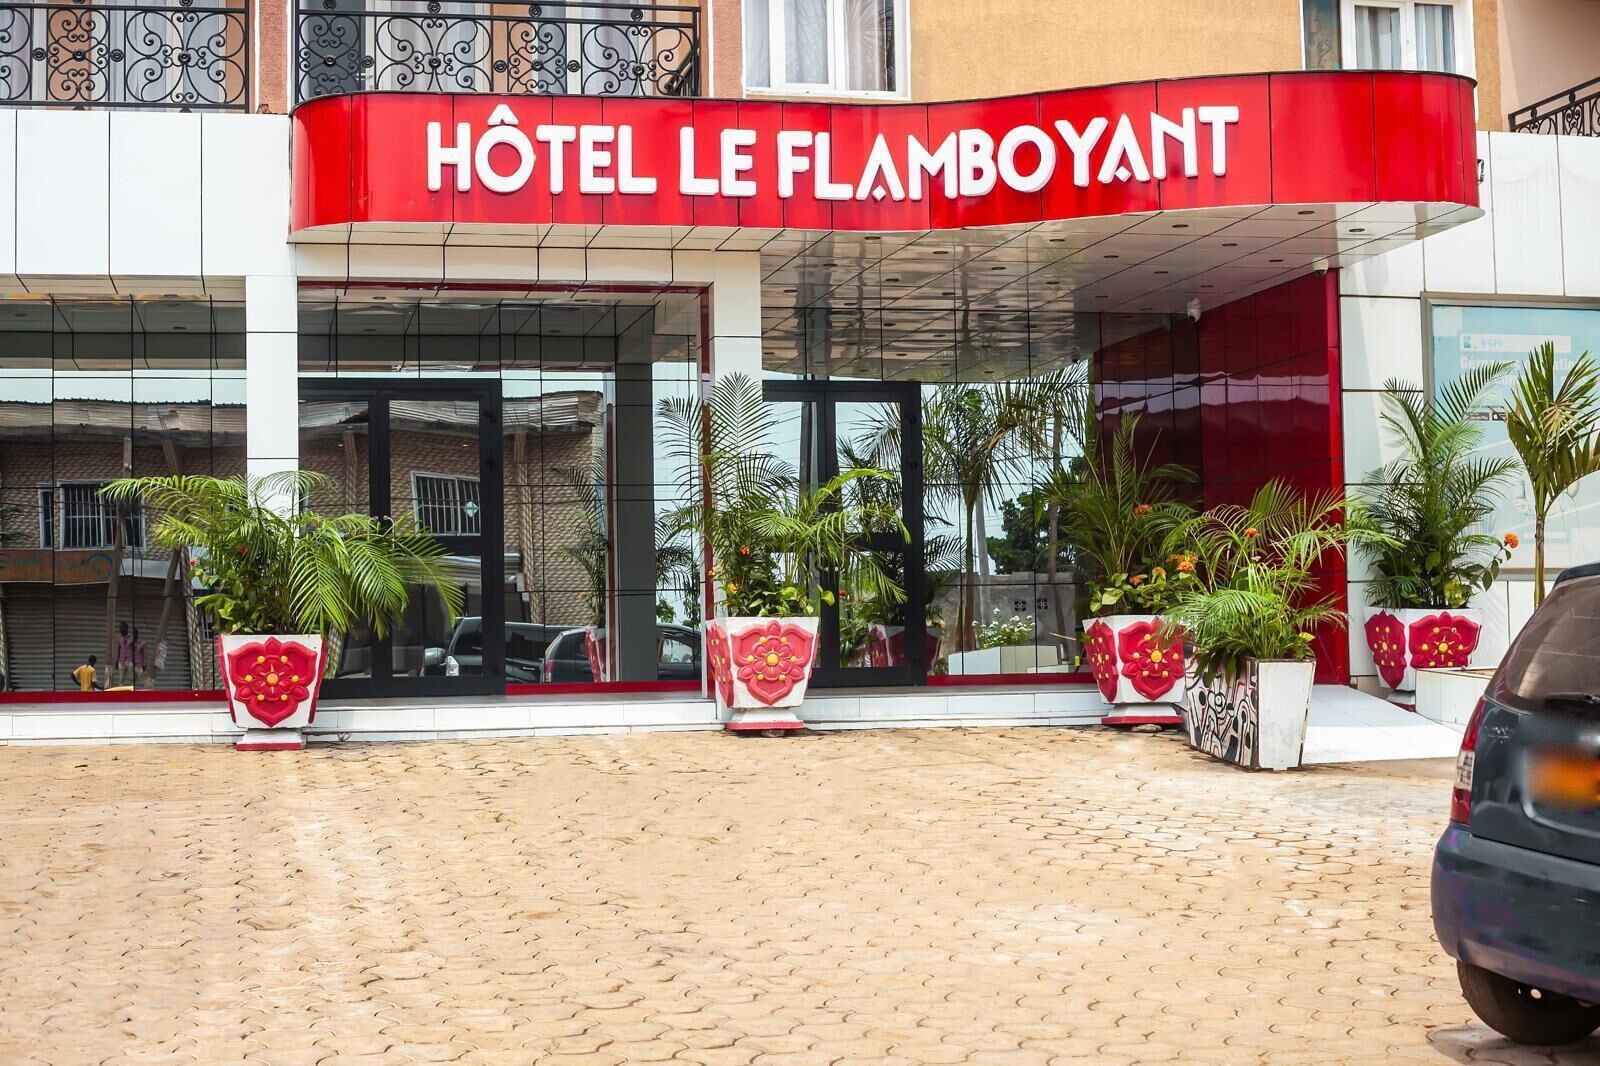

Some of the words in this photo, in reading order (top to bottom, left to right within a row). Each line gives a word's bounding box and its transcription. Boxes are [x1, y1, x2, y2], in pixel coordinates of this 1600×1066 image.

[427, 104, 658, 195] HÔTEL
[679, 126, 757, 197] LE
[776, 105, 1240, 201] FLAMBOYANT
